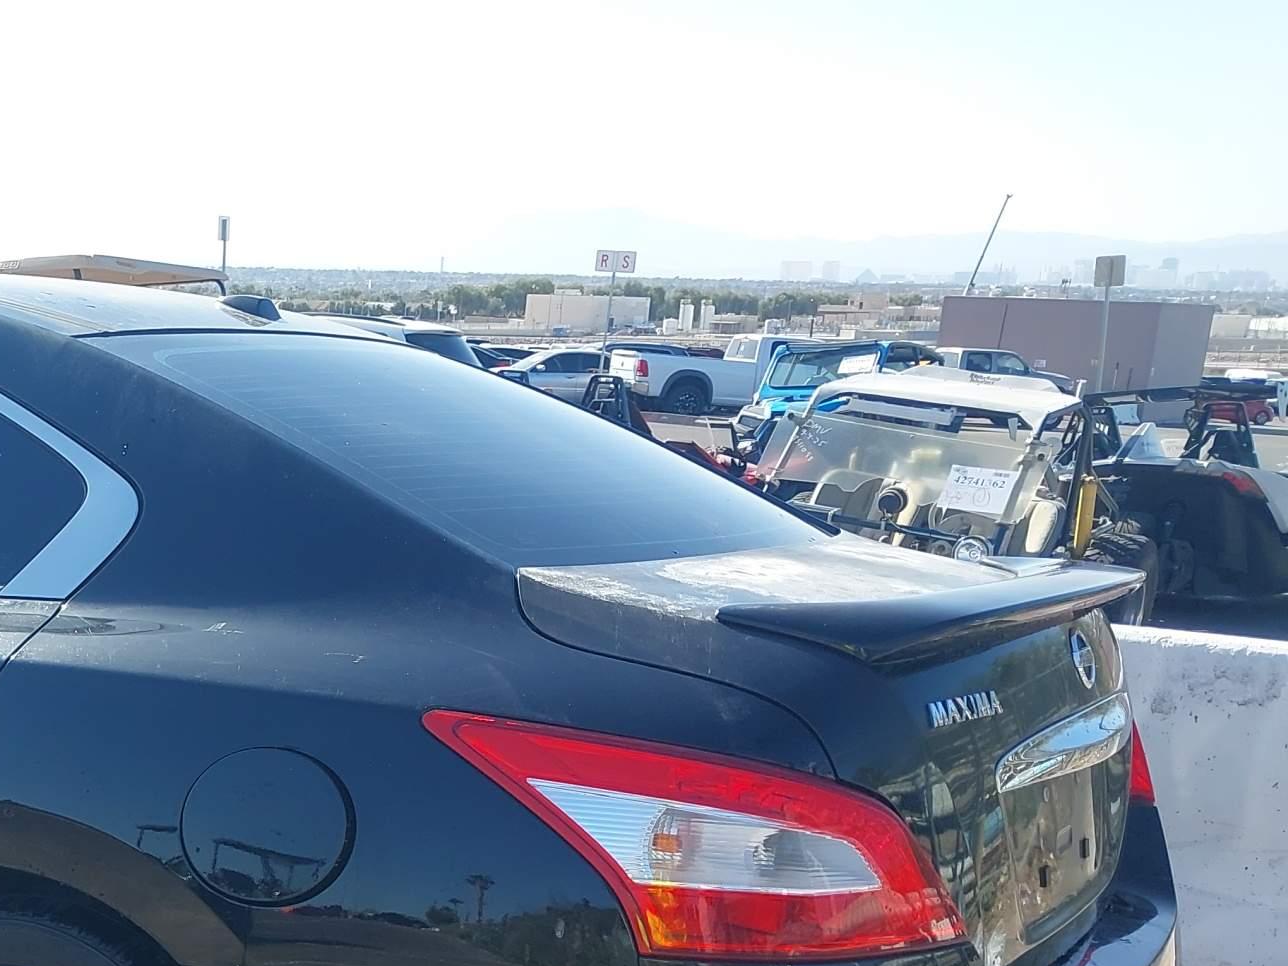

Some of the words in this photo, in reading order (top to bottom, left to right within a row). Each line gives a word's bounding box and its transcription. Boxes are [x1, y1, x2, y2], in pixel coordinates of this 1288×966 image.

[600, 254, 609, 267] R
[622, 255, 630, 268] S
[802, 419, 832, 434] DMV
[927, 690, 1004, 728] MAXIMA
